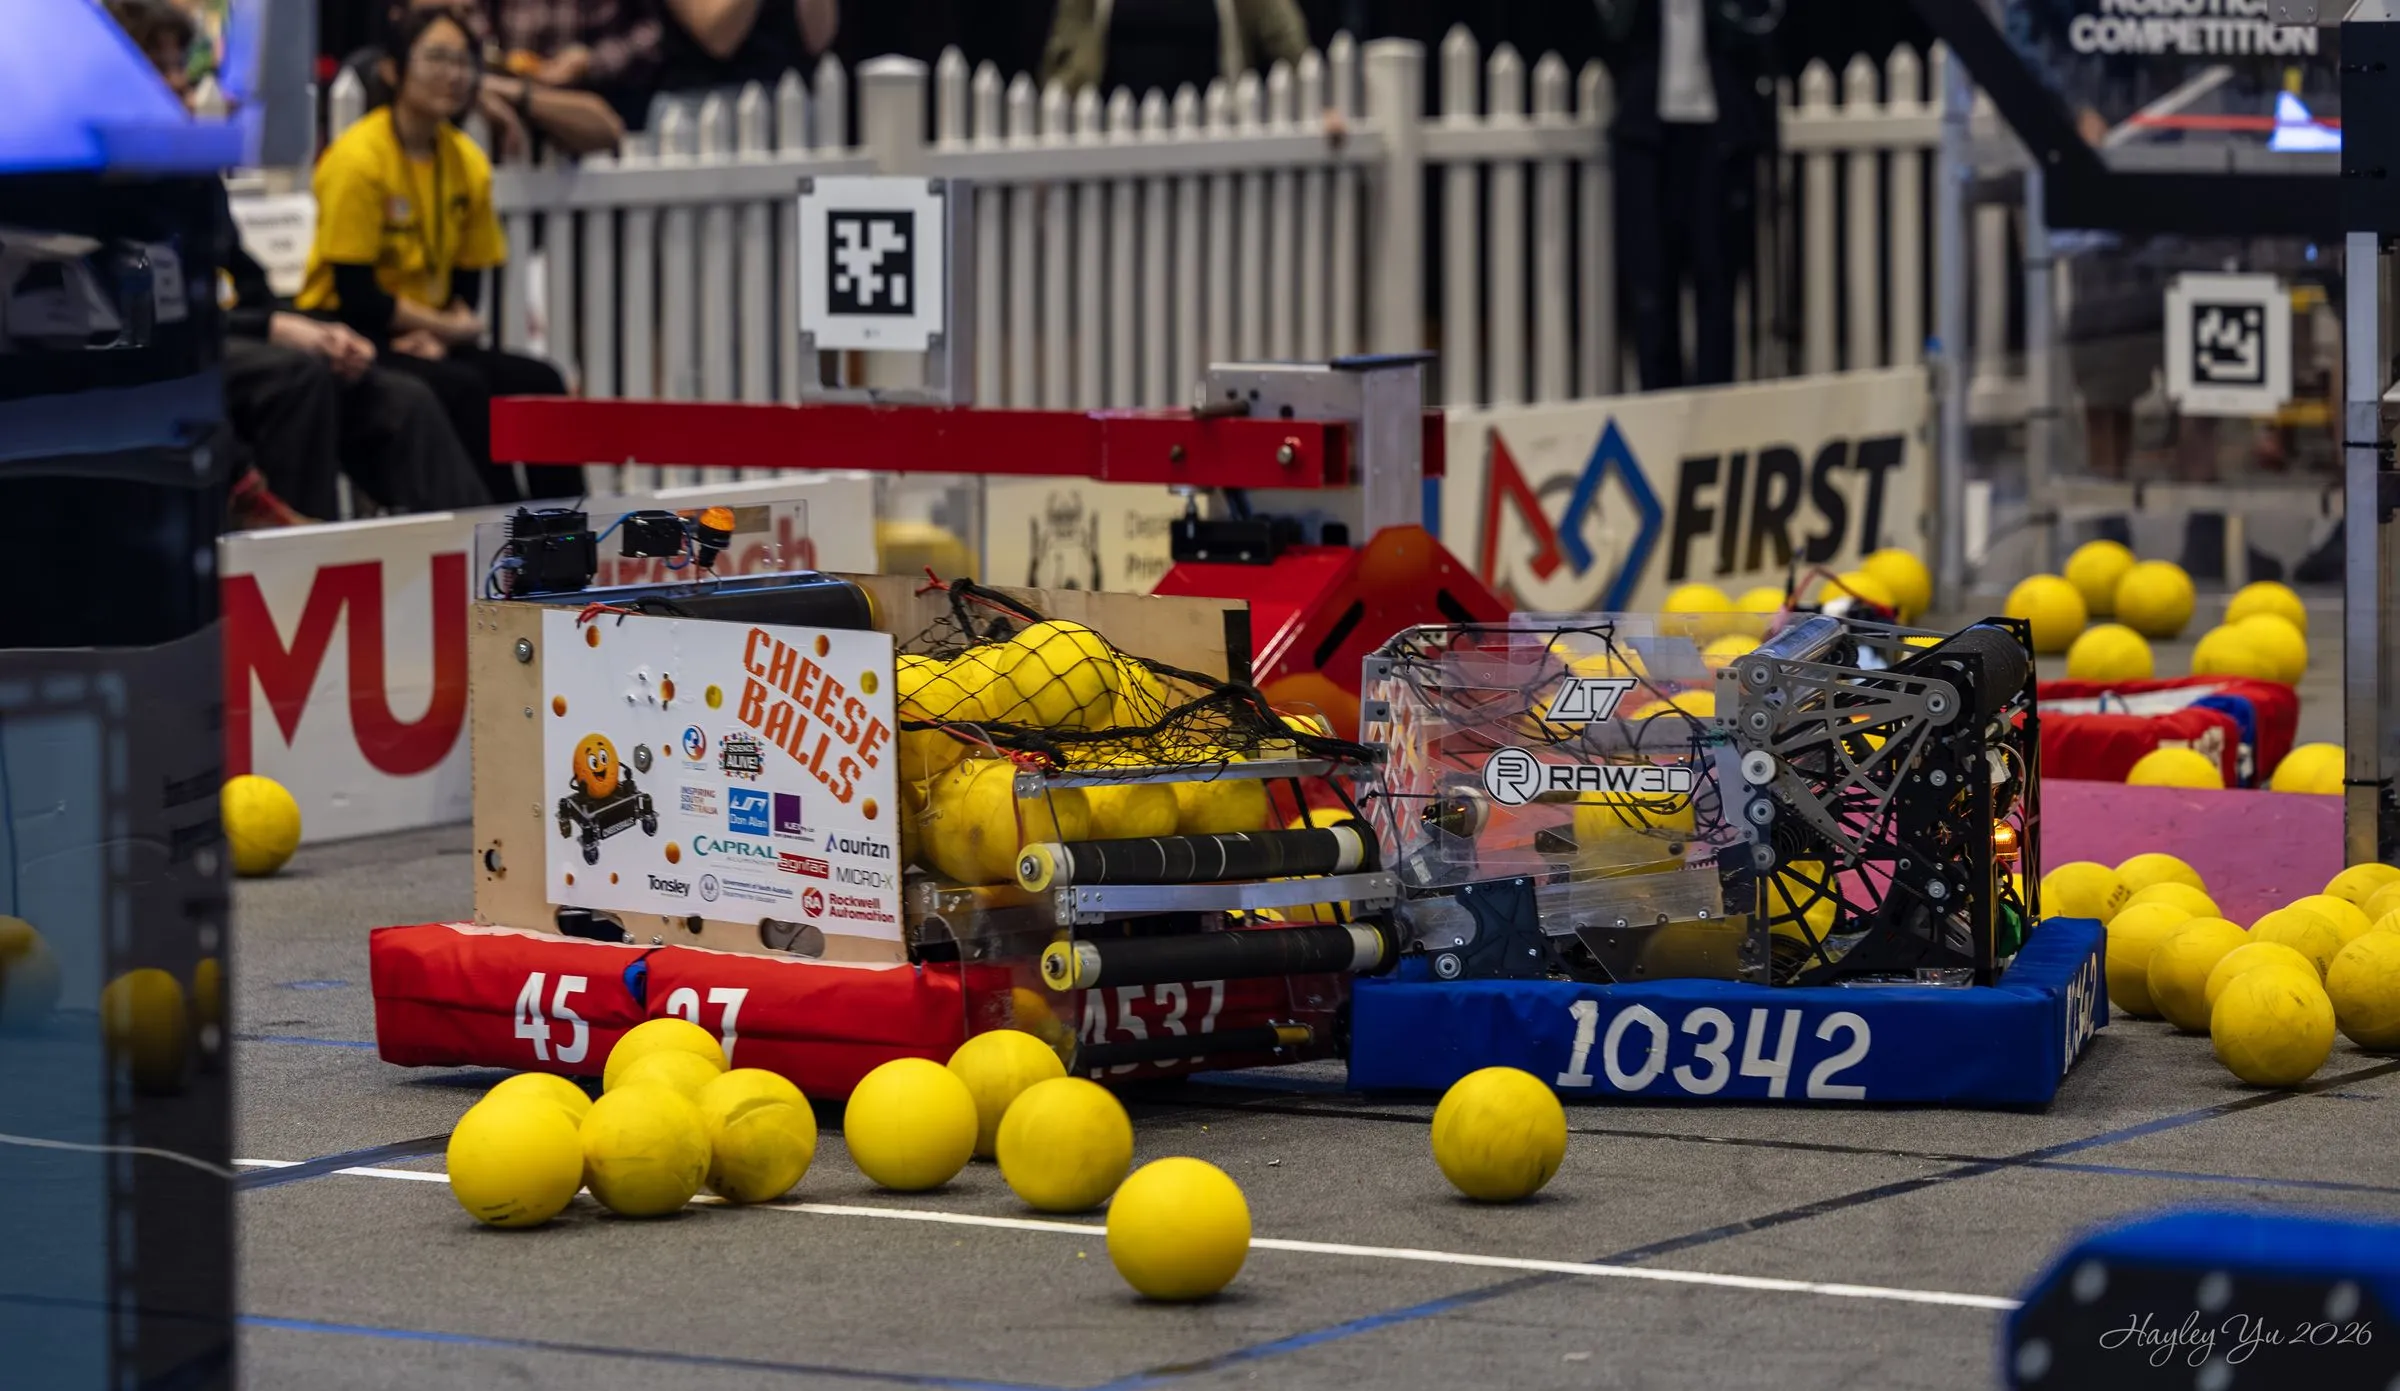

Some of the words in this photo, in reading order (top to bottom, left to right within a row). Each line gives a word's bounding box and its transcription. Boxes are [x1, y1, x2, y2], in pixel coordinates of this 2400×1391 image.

[2069, 13, 2318, 54] COMPETITION
[1667, 430, 1906, 583] FIRST
[743, 627, 891, 769] CHEESE
[738, 677, 862, 804] BALLS
[1550, 766, 1692, 793] RAW3D
[730, 813, 747, 825] Don
[693, 835, 780, 859] CAPRAL
[840, 836, 890, 859] aurizn
[647, 874, 690, 896] Tonsley
[836, 867, 894, 890] MICRO-X
[829, 893, 880, 909] Rockwell
[829, 906, 895, 923] Automation
[1556, 1000, 1871, 1100] 10342
